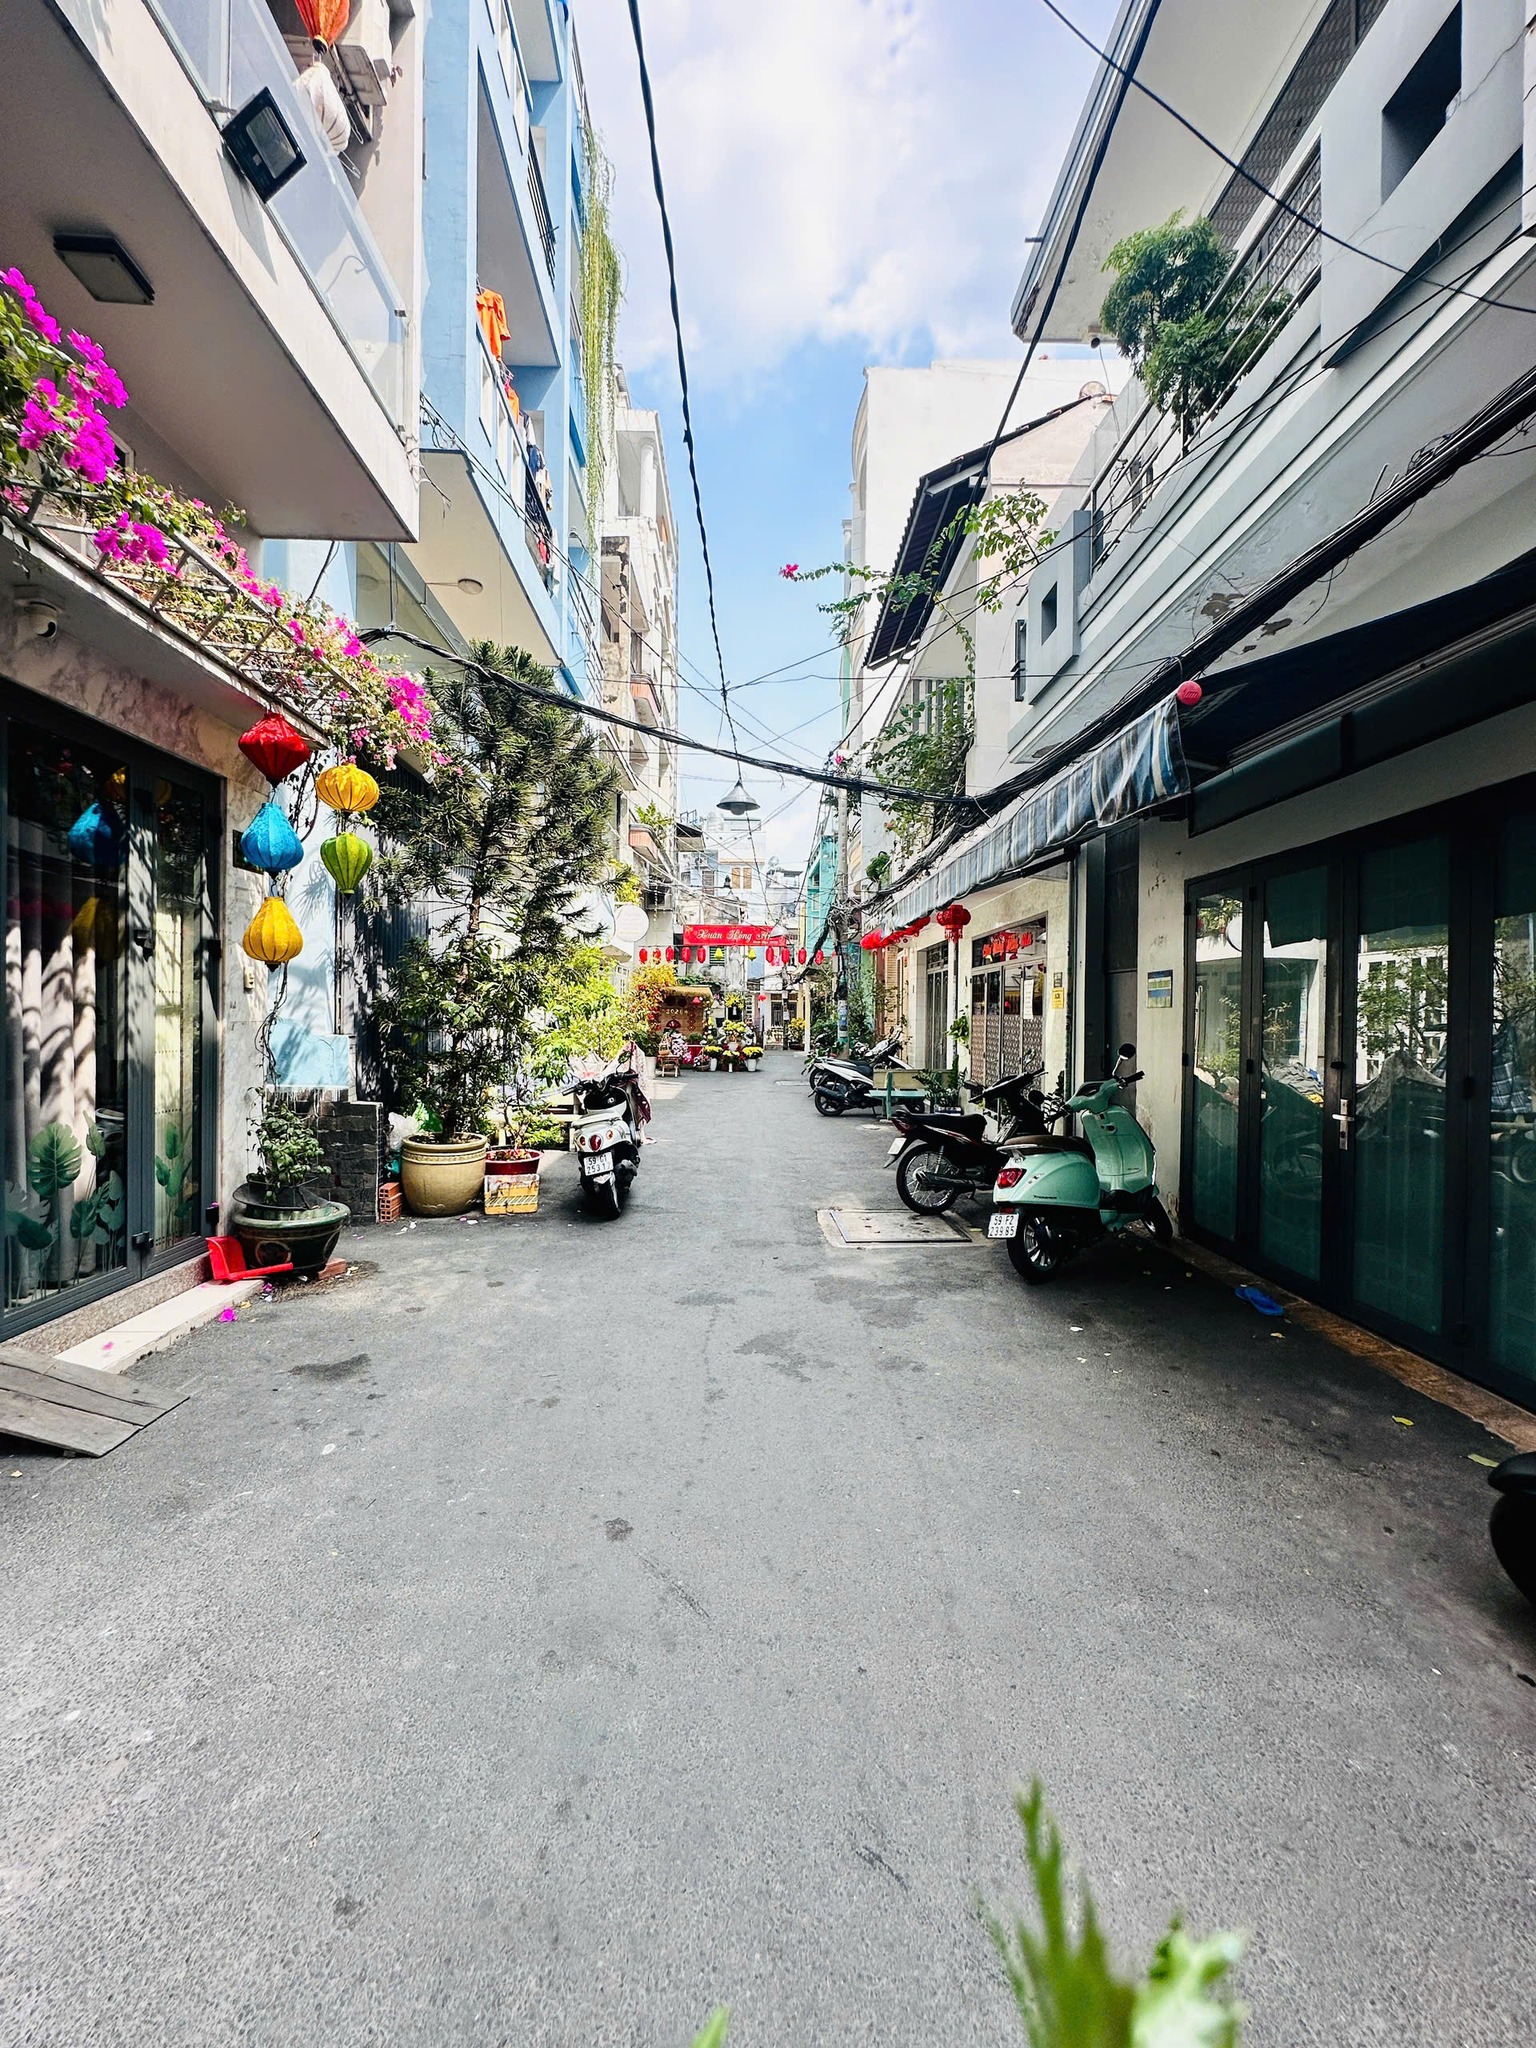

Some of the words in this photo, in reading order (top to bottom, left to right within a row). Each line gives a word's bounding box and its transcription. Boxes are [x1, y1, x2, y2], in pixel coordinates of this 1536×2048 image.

[588, 1156, 597, 1165] 59
[994, 1215, 1003, 1225] 59
[1005, 1215, 1014, 1225] F2
